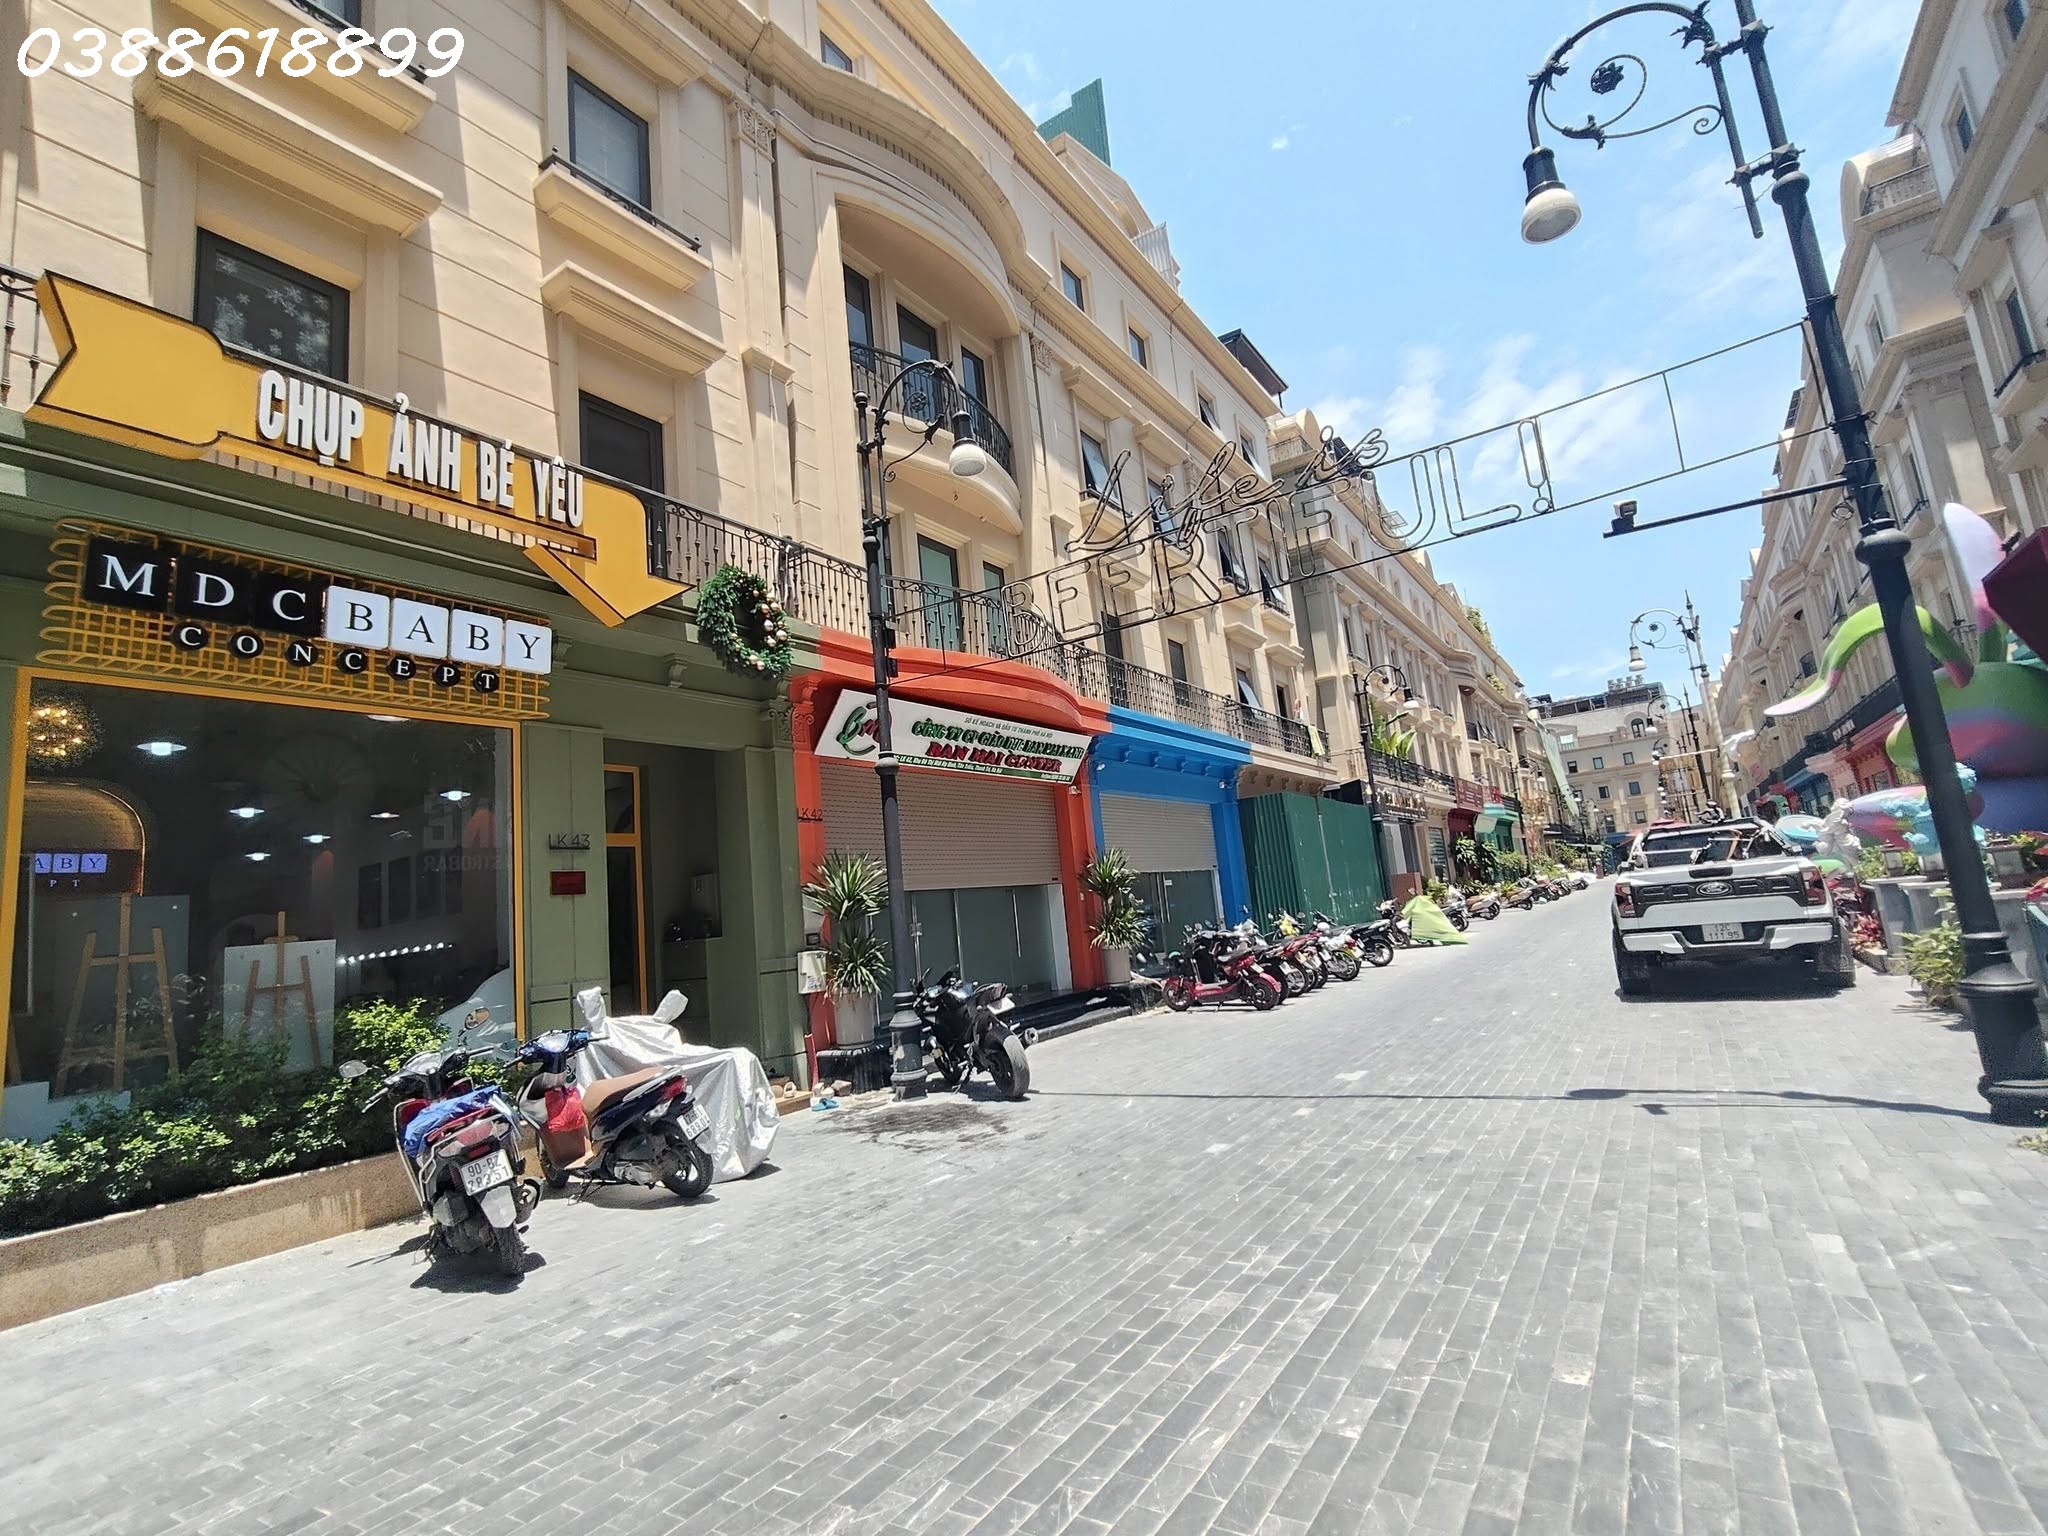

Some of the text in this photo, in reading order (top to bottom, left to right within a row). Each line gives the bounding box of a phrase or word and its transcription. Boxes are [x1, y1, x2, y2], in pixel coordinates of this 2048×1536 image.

[257, 369, 585, 528] CHỤP ẢNH BÉ YÊU
[1066, 441, 1284, 554] Life
[179, 625, 499, 690] CONCEPT
[911, 717, 946, 739] CÔNG
[925, 741, 1062, 773] BAN MAI CENTER
[810, 807, 823, 819] 42
[549, 833, 591, 849] LK 43
